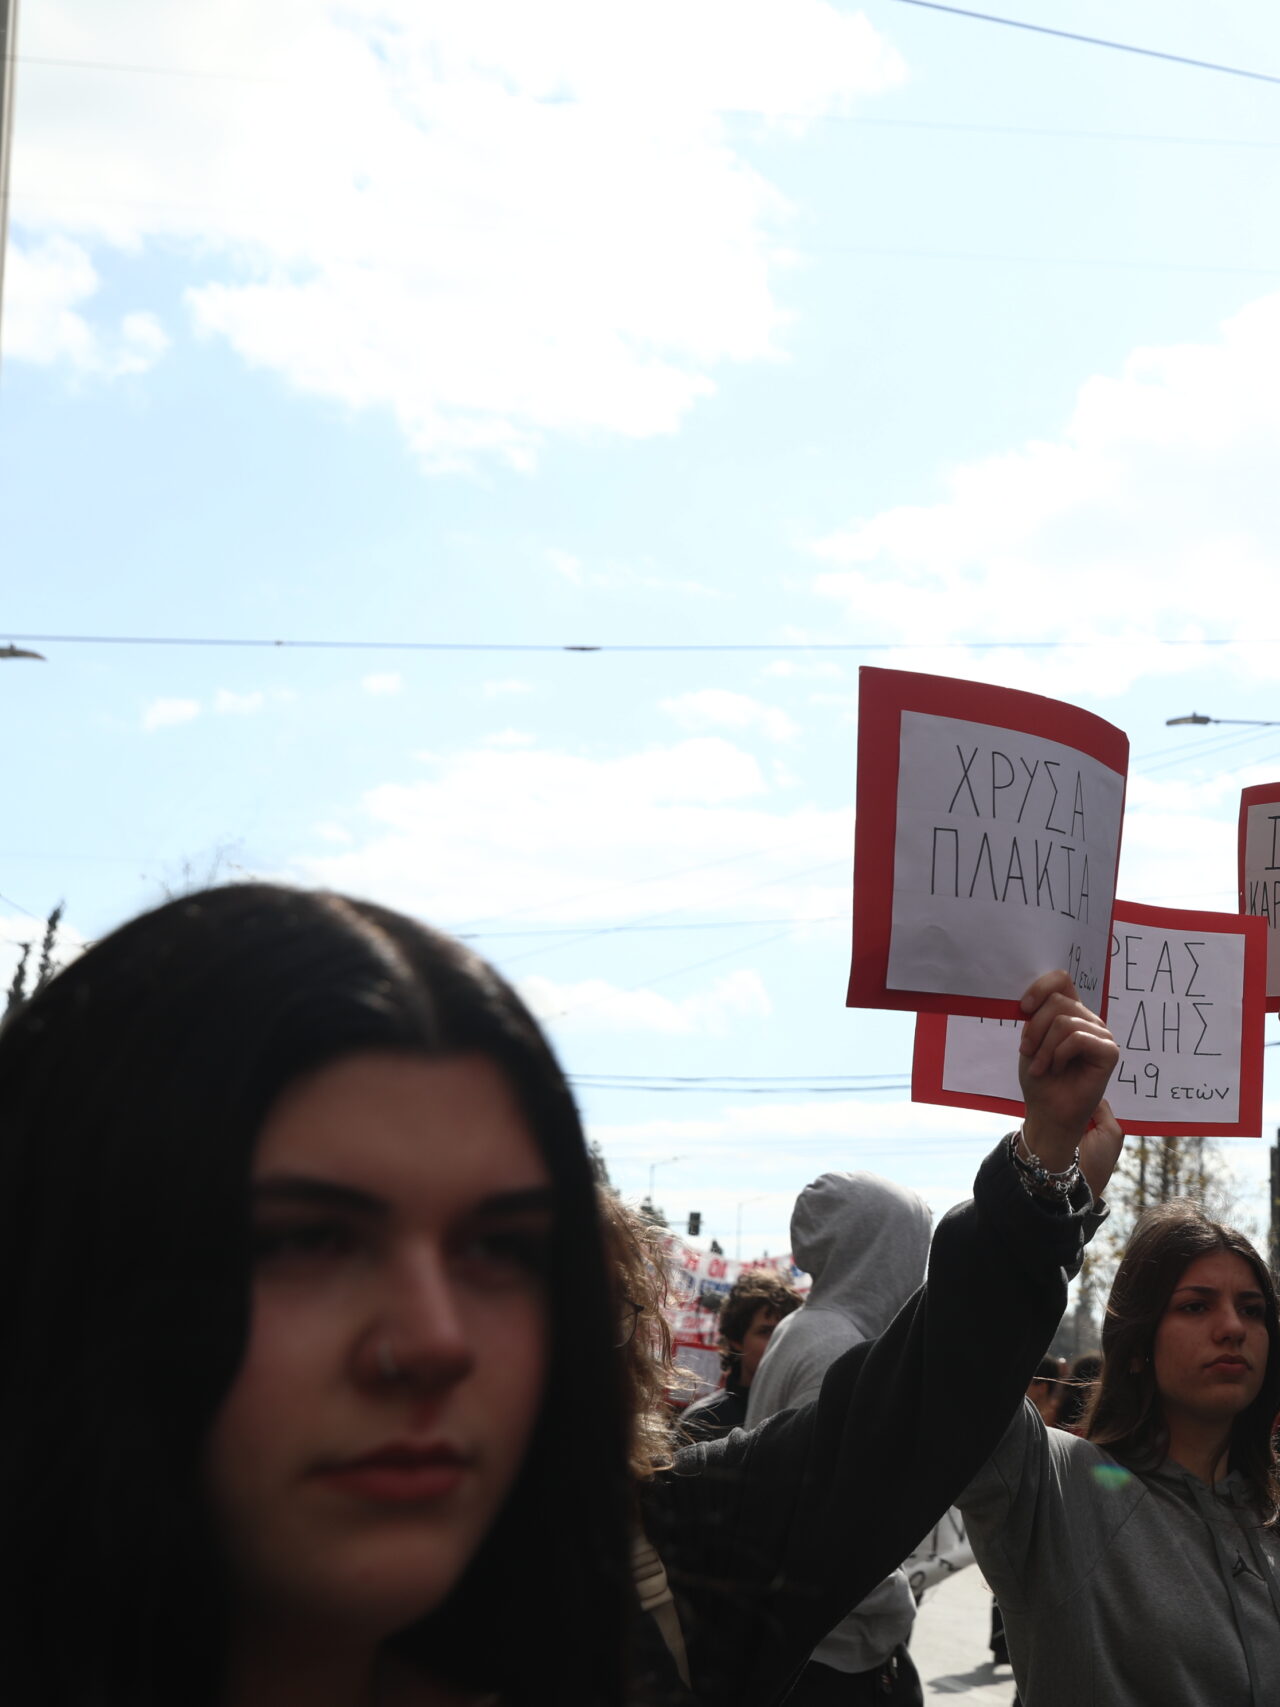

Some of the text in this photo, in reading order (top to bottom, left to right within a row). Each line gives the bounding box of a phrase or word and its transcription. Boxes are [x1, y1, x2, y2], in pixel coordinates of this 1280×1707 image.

[949, 745, 1085, 841] ΧΡΥΣΑ
[931, 826, 1089, 924] ΠΛΑΚΙΑ
[1068, 942, 1081, 986] 19
[1118, 1061, 1230, 1100] 49 ετών
